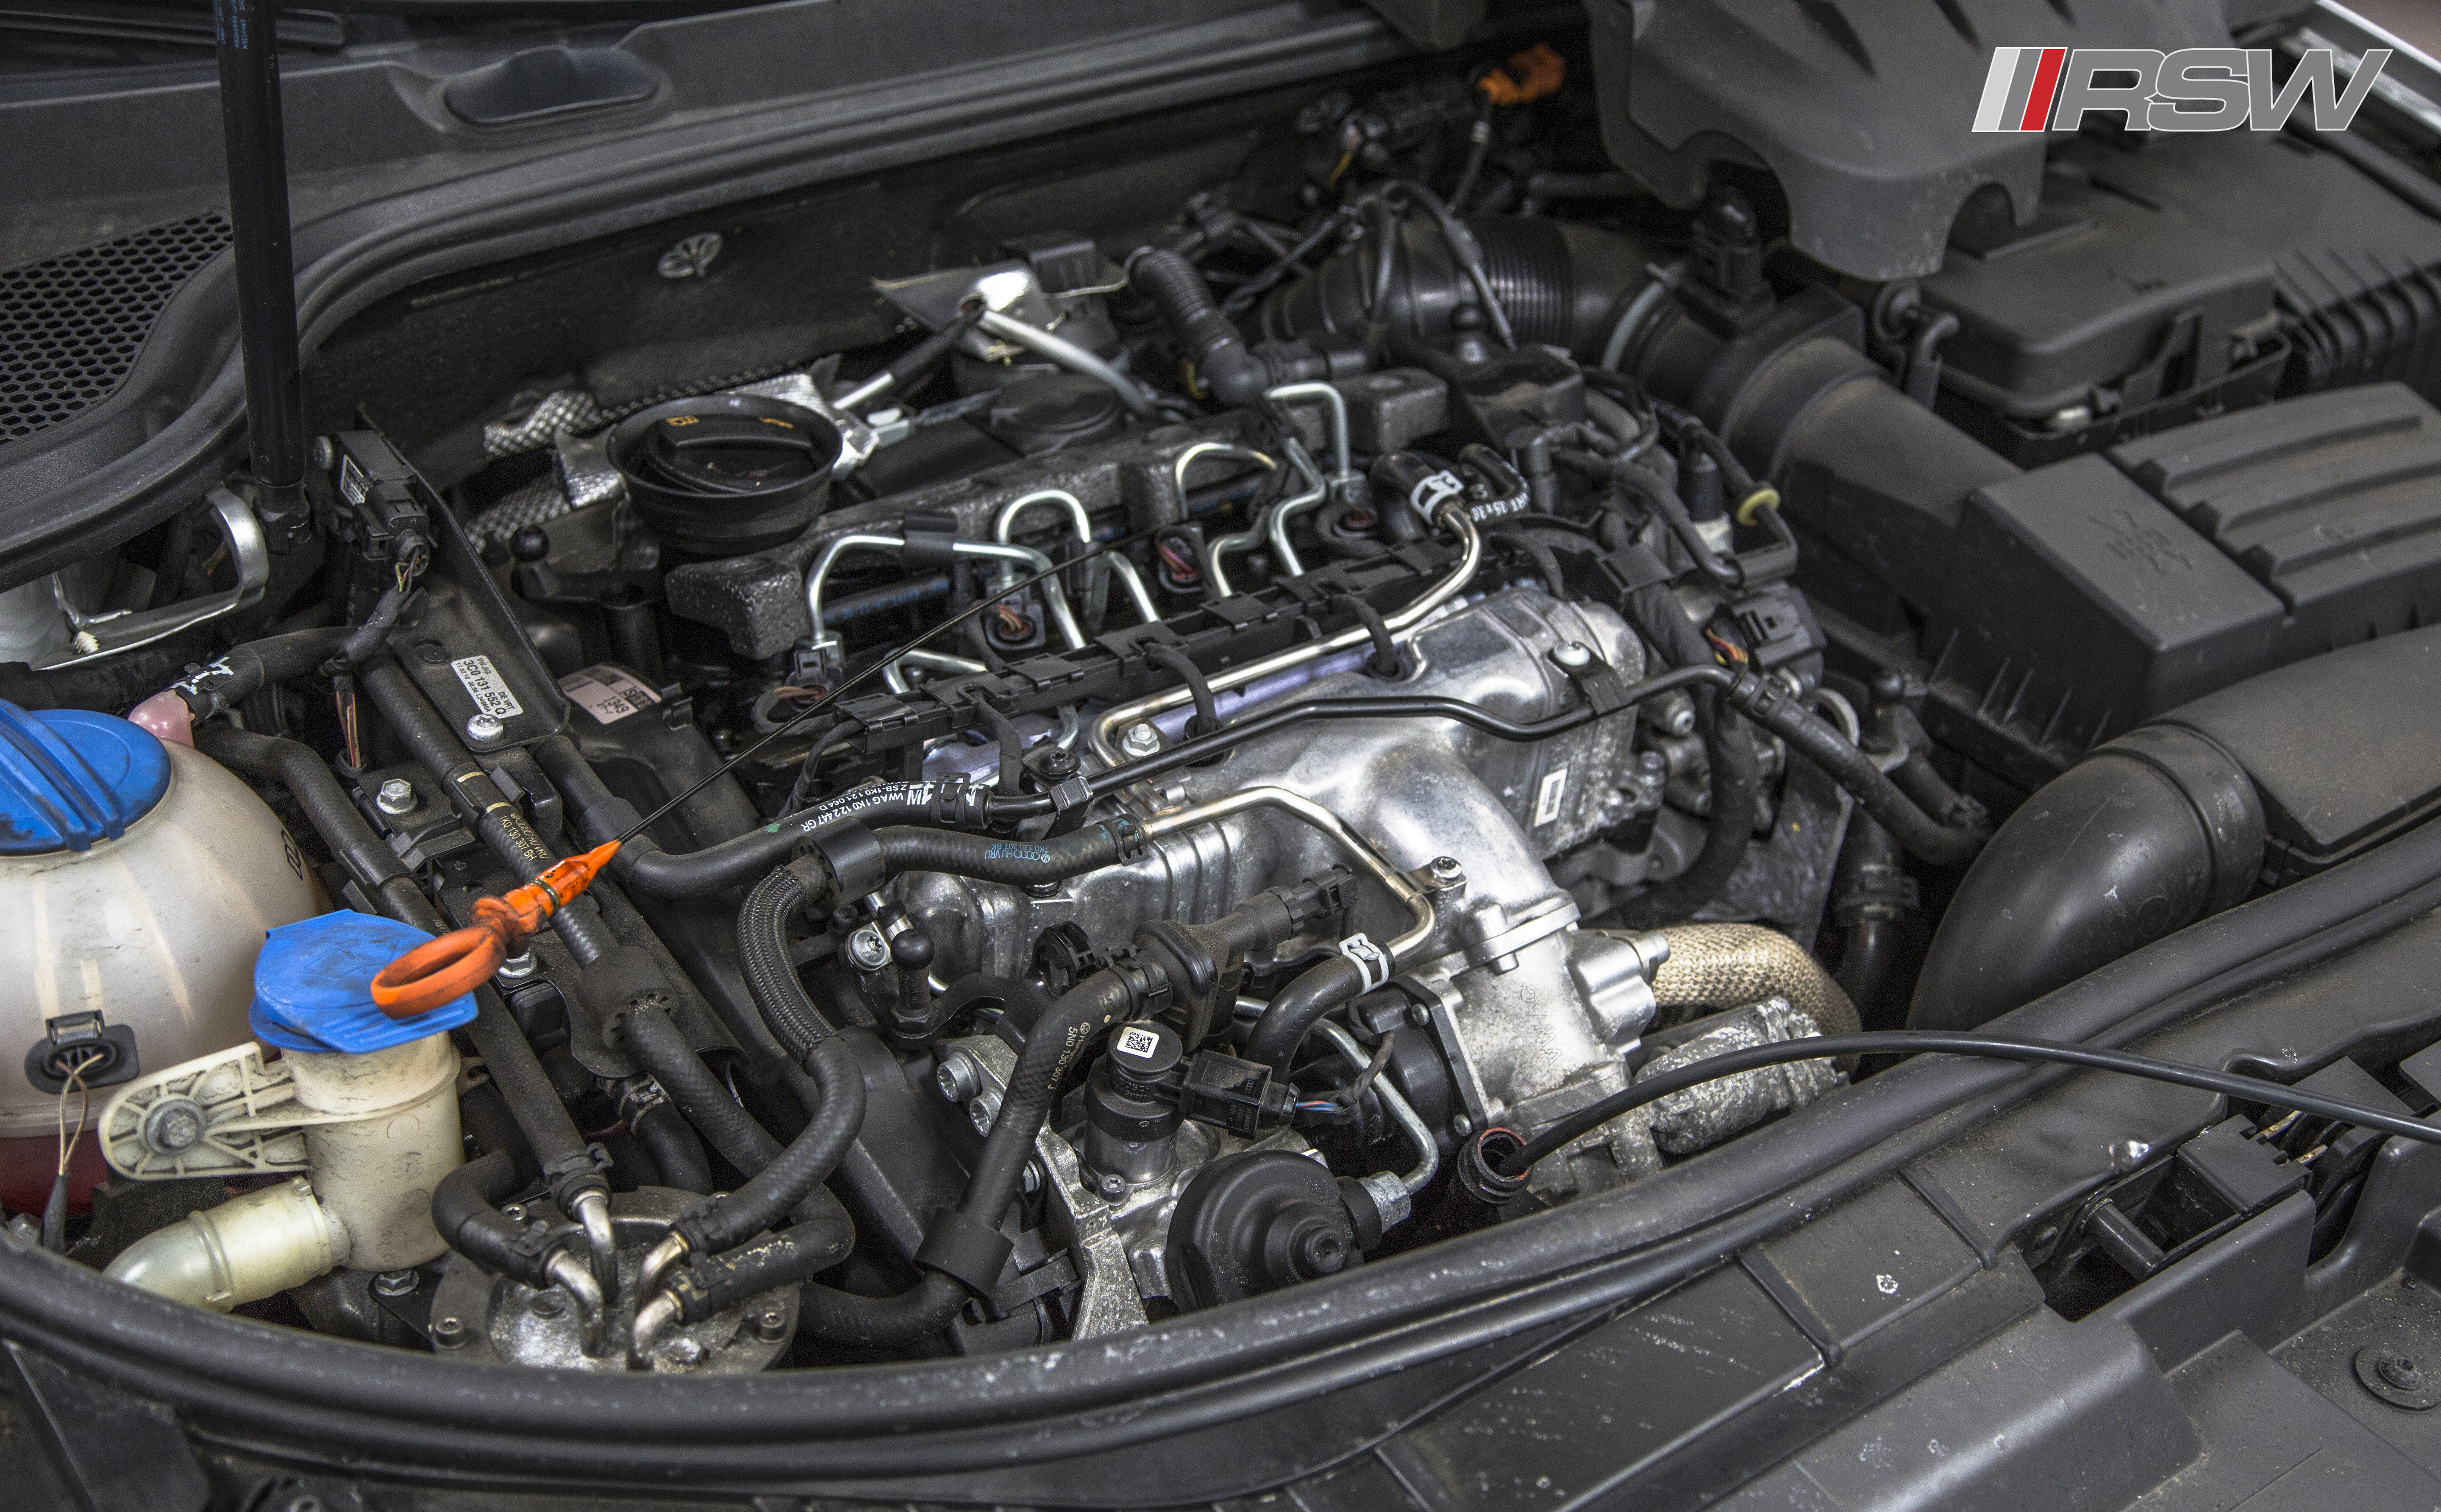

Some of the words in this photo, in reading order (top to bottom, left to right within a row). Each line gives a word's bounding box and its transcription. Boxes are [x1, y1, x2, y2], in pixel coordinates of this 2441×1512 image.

[463, 659, 482, 676] 3C0
[474, 676, 491, 690] 131
[484, 691, 501, 706] 552
[494, 706, 507, 715] Q
[481, 666, 492, 674] AG
[503, 699, 515, 710] VRT
[827, 797, 845, 808] 064
[845, 791, 863, 801] 121
[851, 798, 870, 811] 1K0
[800, 818, 817, 832] GR
[498, 814, 513, 828] 1K0
[507, 826, 521, 839] 130
[514, 837, 529, 850] 307
[523, 848, 537, 862] BH
[527, 836, 540, 845] HU
[534, 845, 549, 858] VRU
[984, 850, 1000, 859] VRU
[1002, 849, 1012, 857] HU
[1034, 845, 1048, 853] 1K0
[1065, 1026, 1078, 1047] 5N0
[1058, 1048, 1070, 1065] 130
[1051, 1066, 1062, 1082] 307
